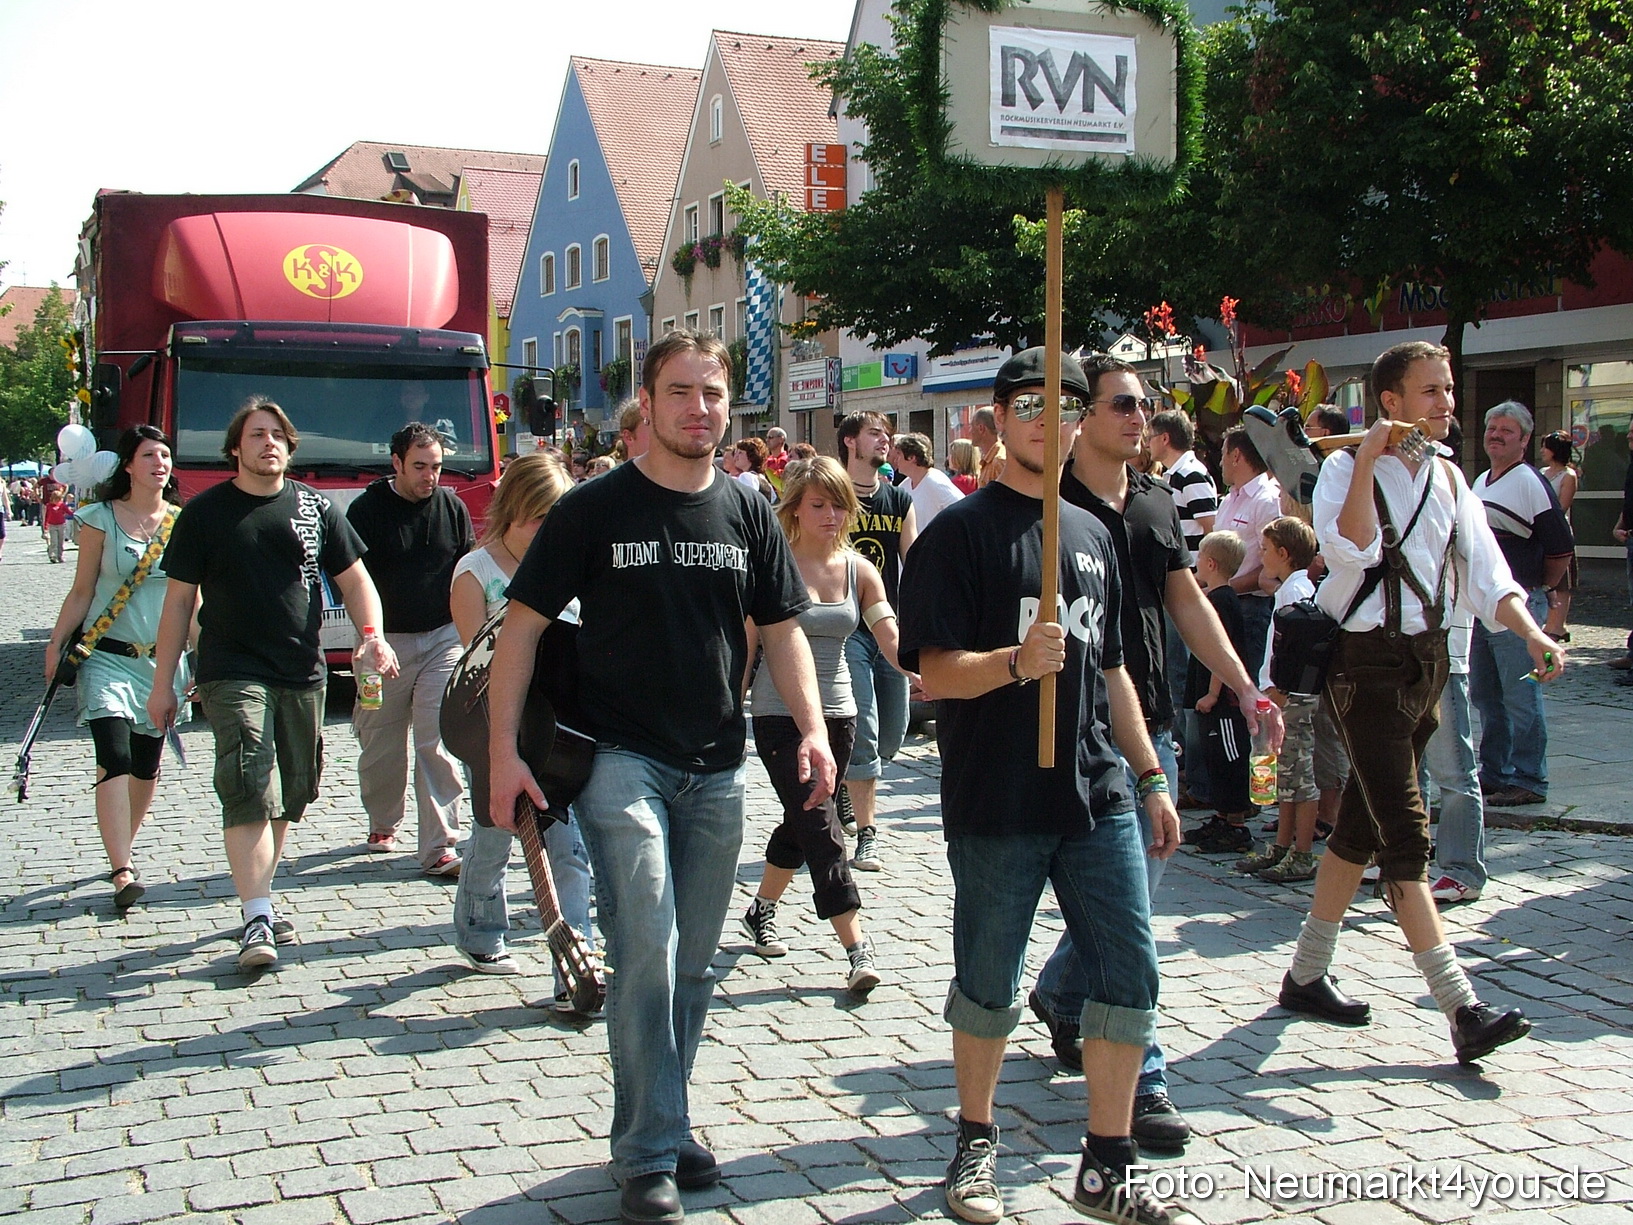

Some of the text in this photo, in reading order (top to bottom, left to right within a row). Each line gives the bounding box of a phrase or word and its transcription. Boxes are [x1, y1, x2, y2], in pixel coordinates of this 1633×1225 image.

[1001, 45, 1128, 116] RVN
[1000, 114, 1072, 126] ROCKMUSIKERVEREIN
[1073, 120, 1111, 129] NEUMARKT
[812, 145, 827, 209] ELE
[612, 541, 660, 569] MUTANT
